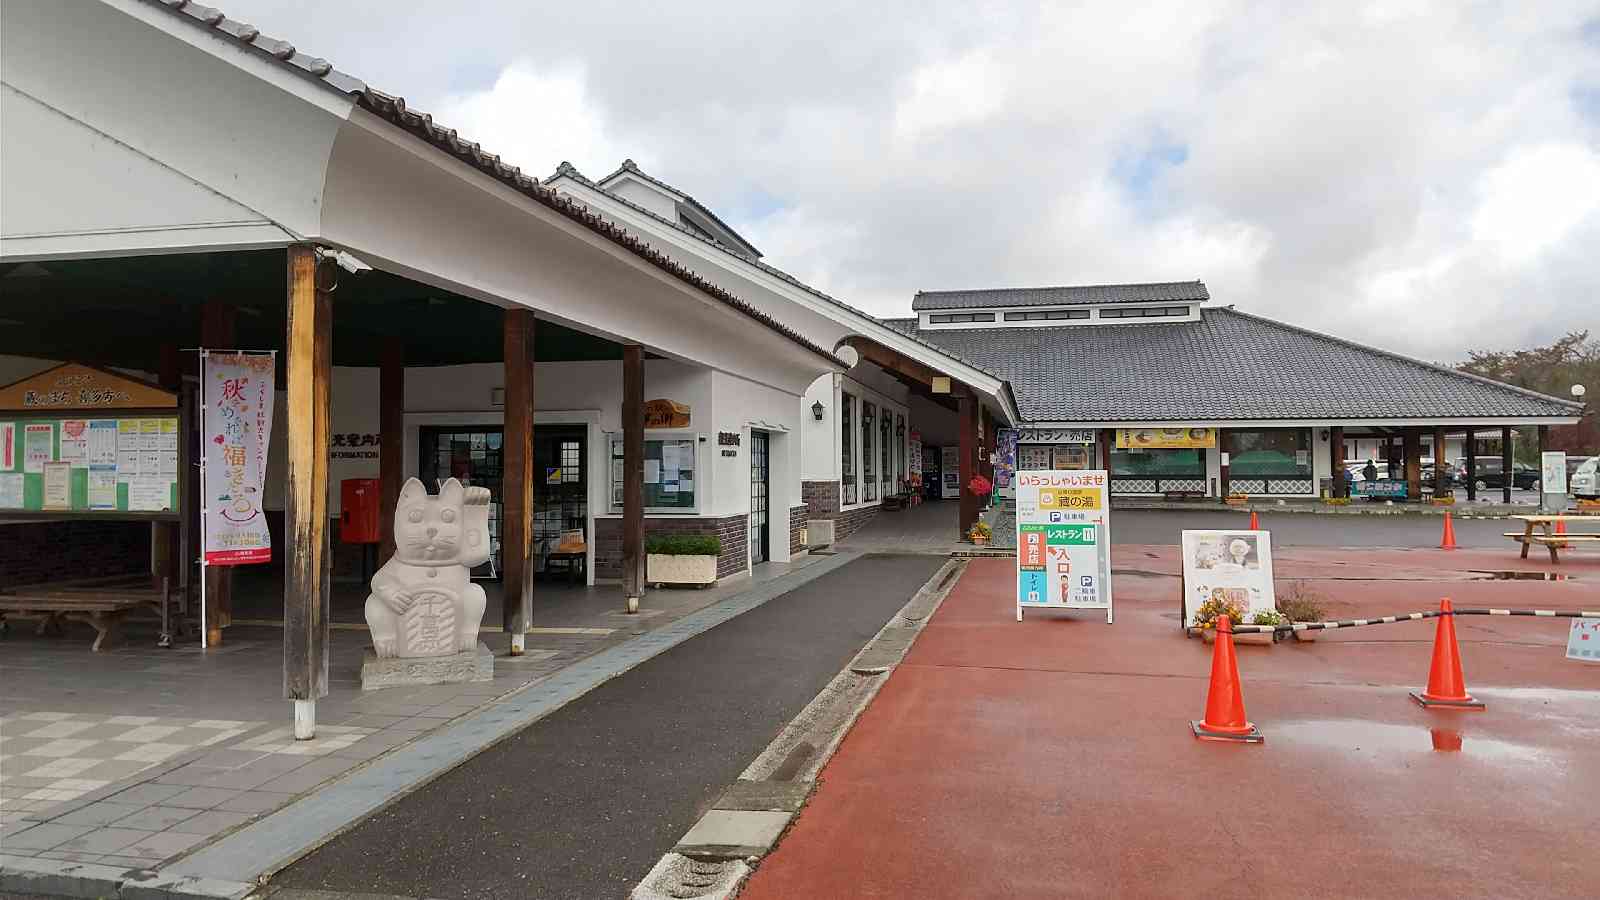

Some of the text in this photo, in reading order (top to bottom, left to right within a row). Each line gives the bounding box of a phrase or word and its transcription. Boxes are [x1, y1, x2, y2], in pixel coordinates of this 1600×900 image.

[1019, 475, 1105, 486] いらっしゃいませ
[1058, 496, 1094, 508] 蔵の湯
[1047, 529, 1082, 540] レストラン
[1056, 548, 1070, 574] 入口
[1031, 573, 1039, 592] トイレ
